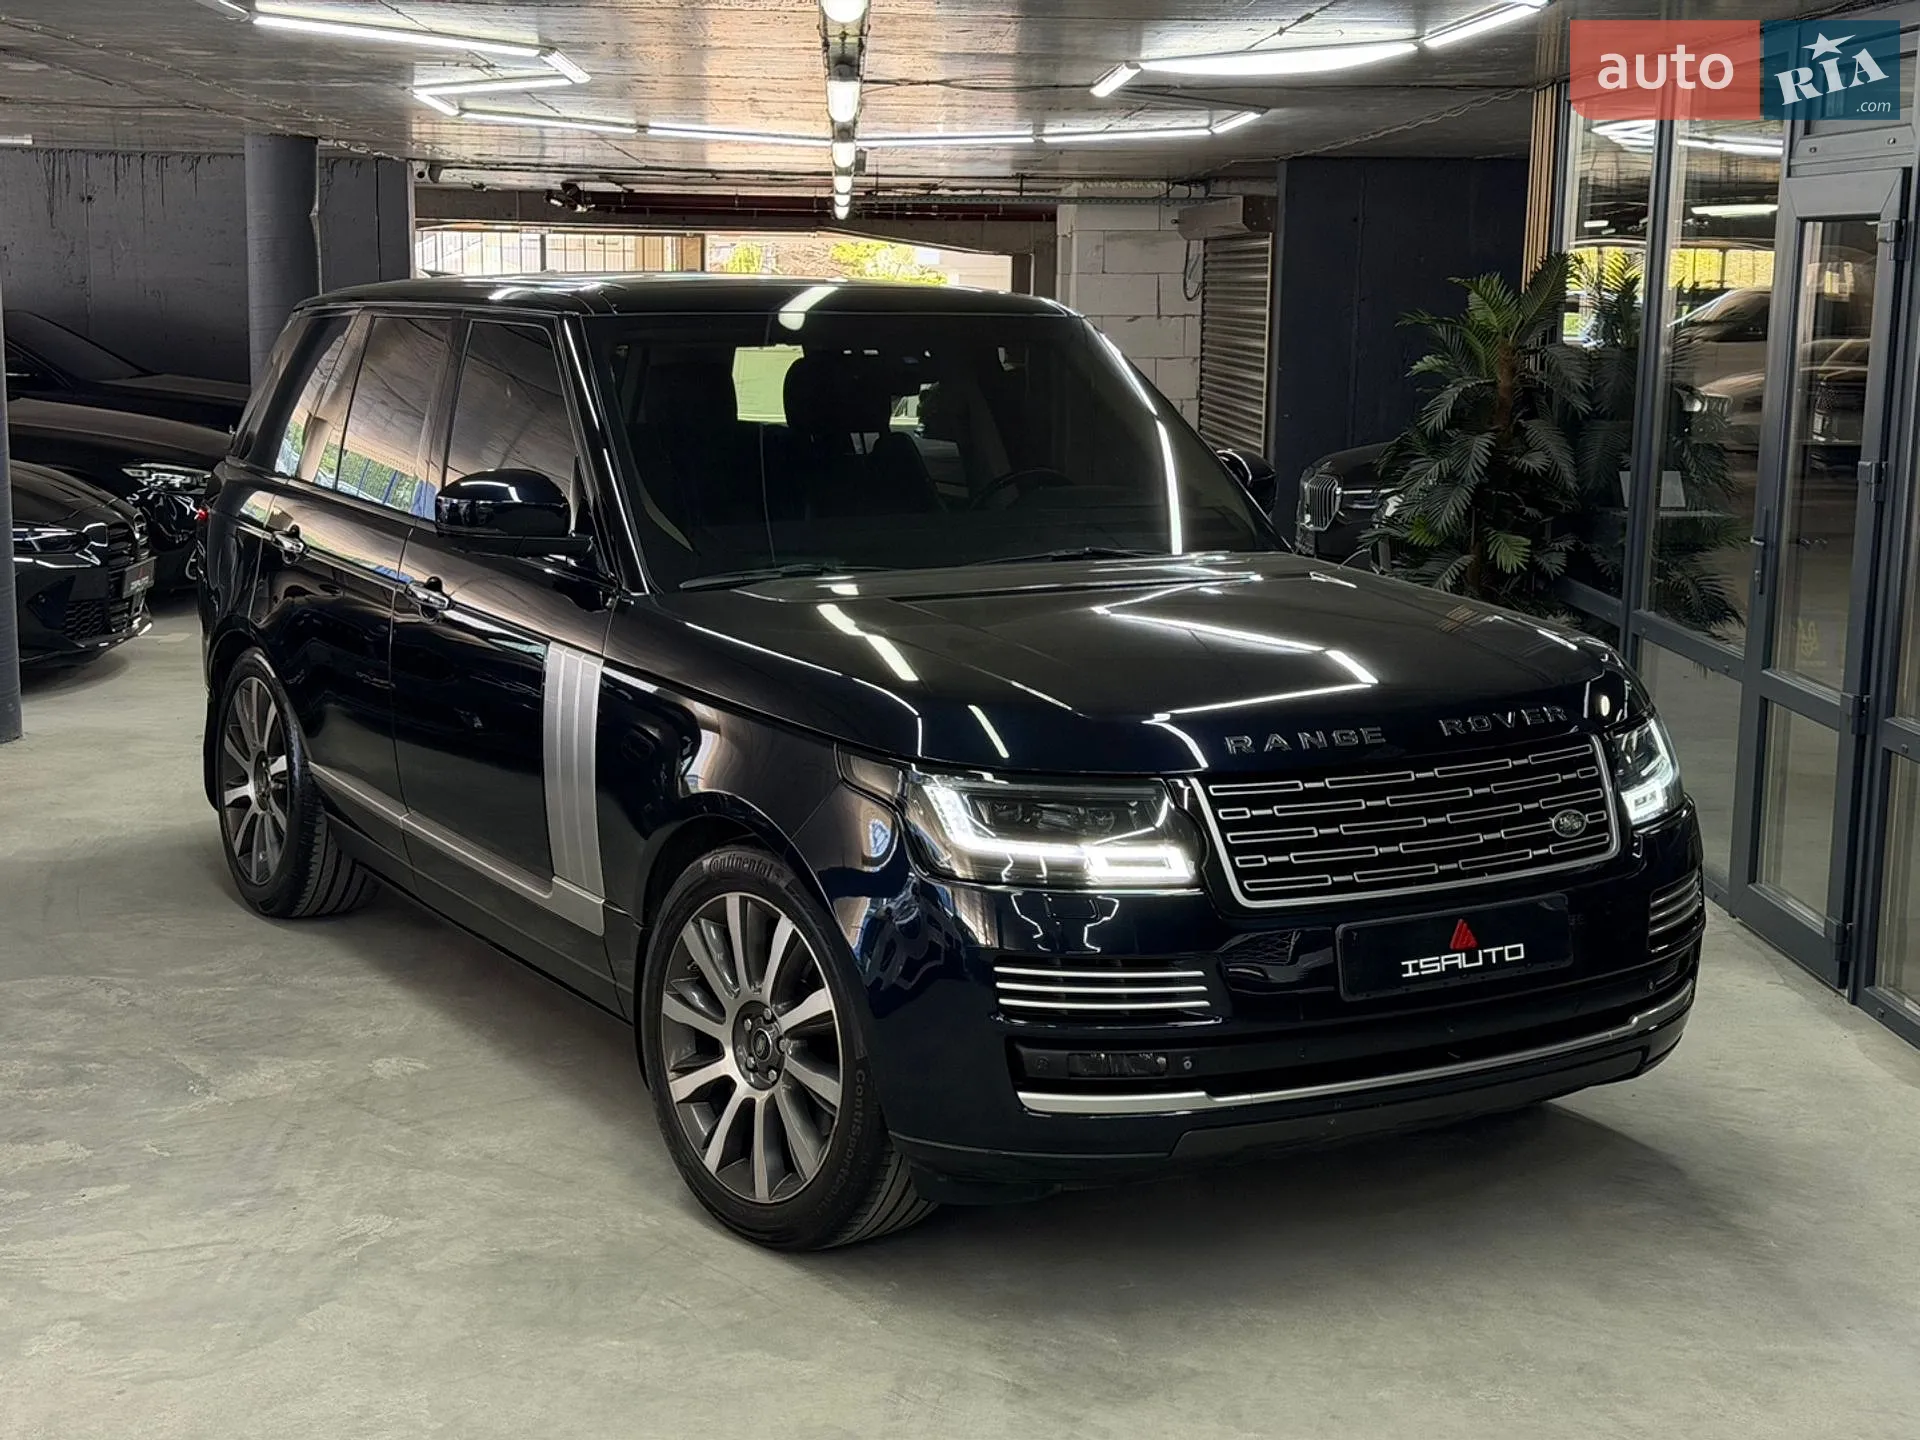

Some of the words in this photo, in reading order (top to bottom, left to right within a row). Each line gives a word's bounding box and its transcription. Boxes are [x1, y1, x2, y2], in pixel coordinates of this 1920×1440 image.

[1224, 726, 1386, 755] RANGE
[1438, 705, 1569, 737] ROVER
[1400, 942, 1526, 978] ISAUTO
